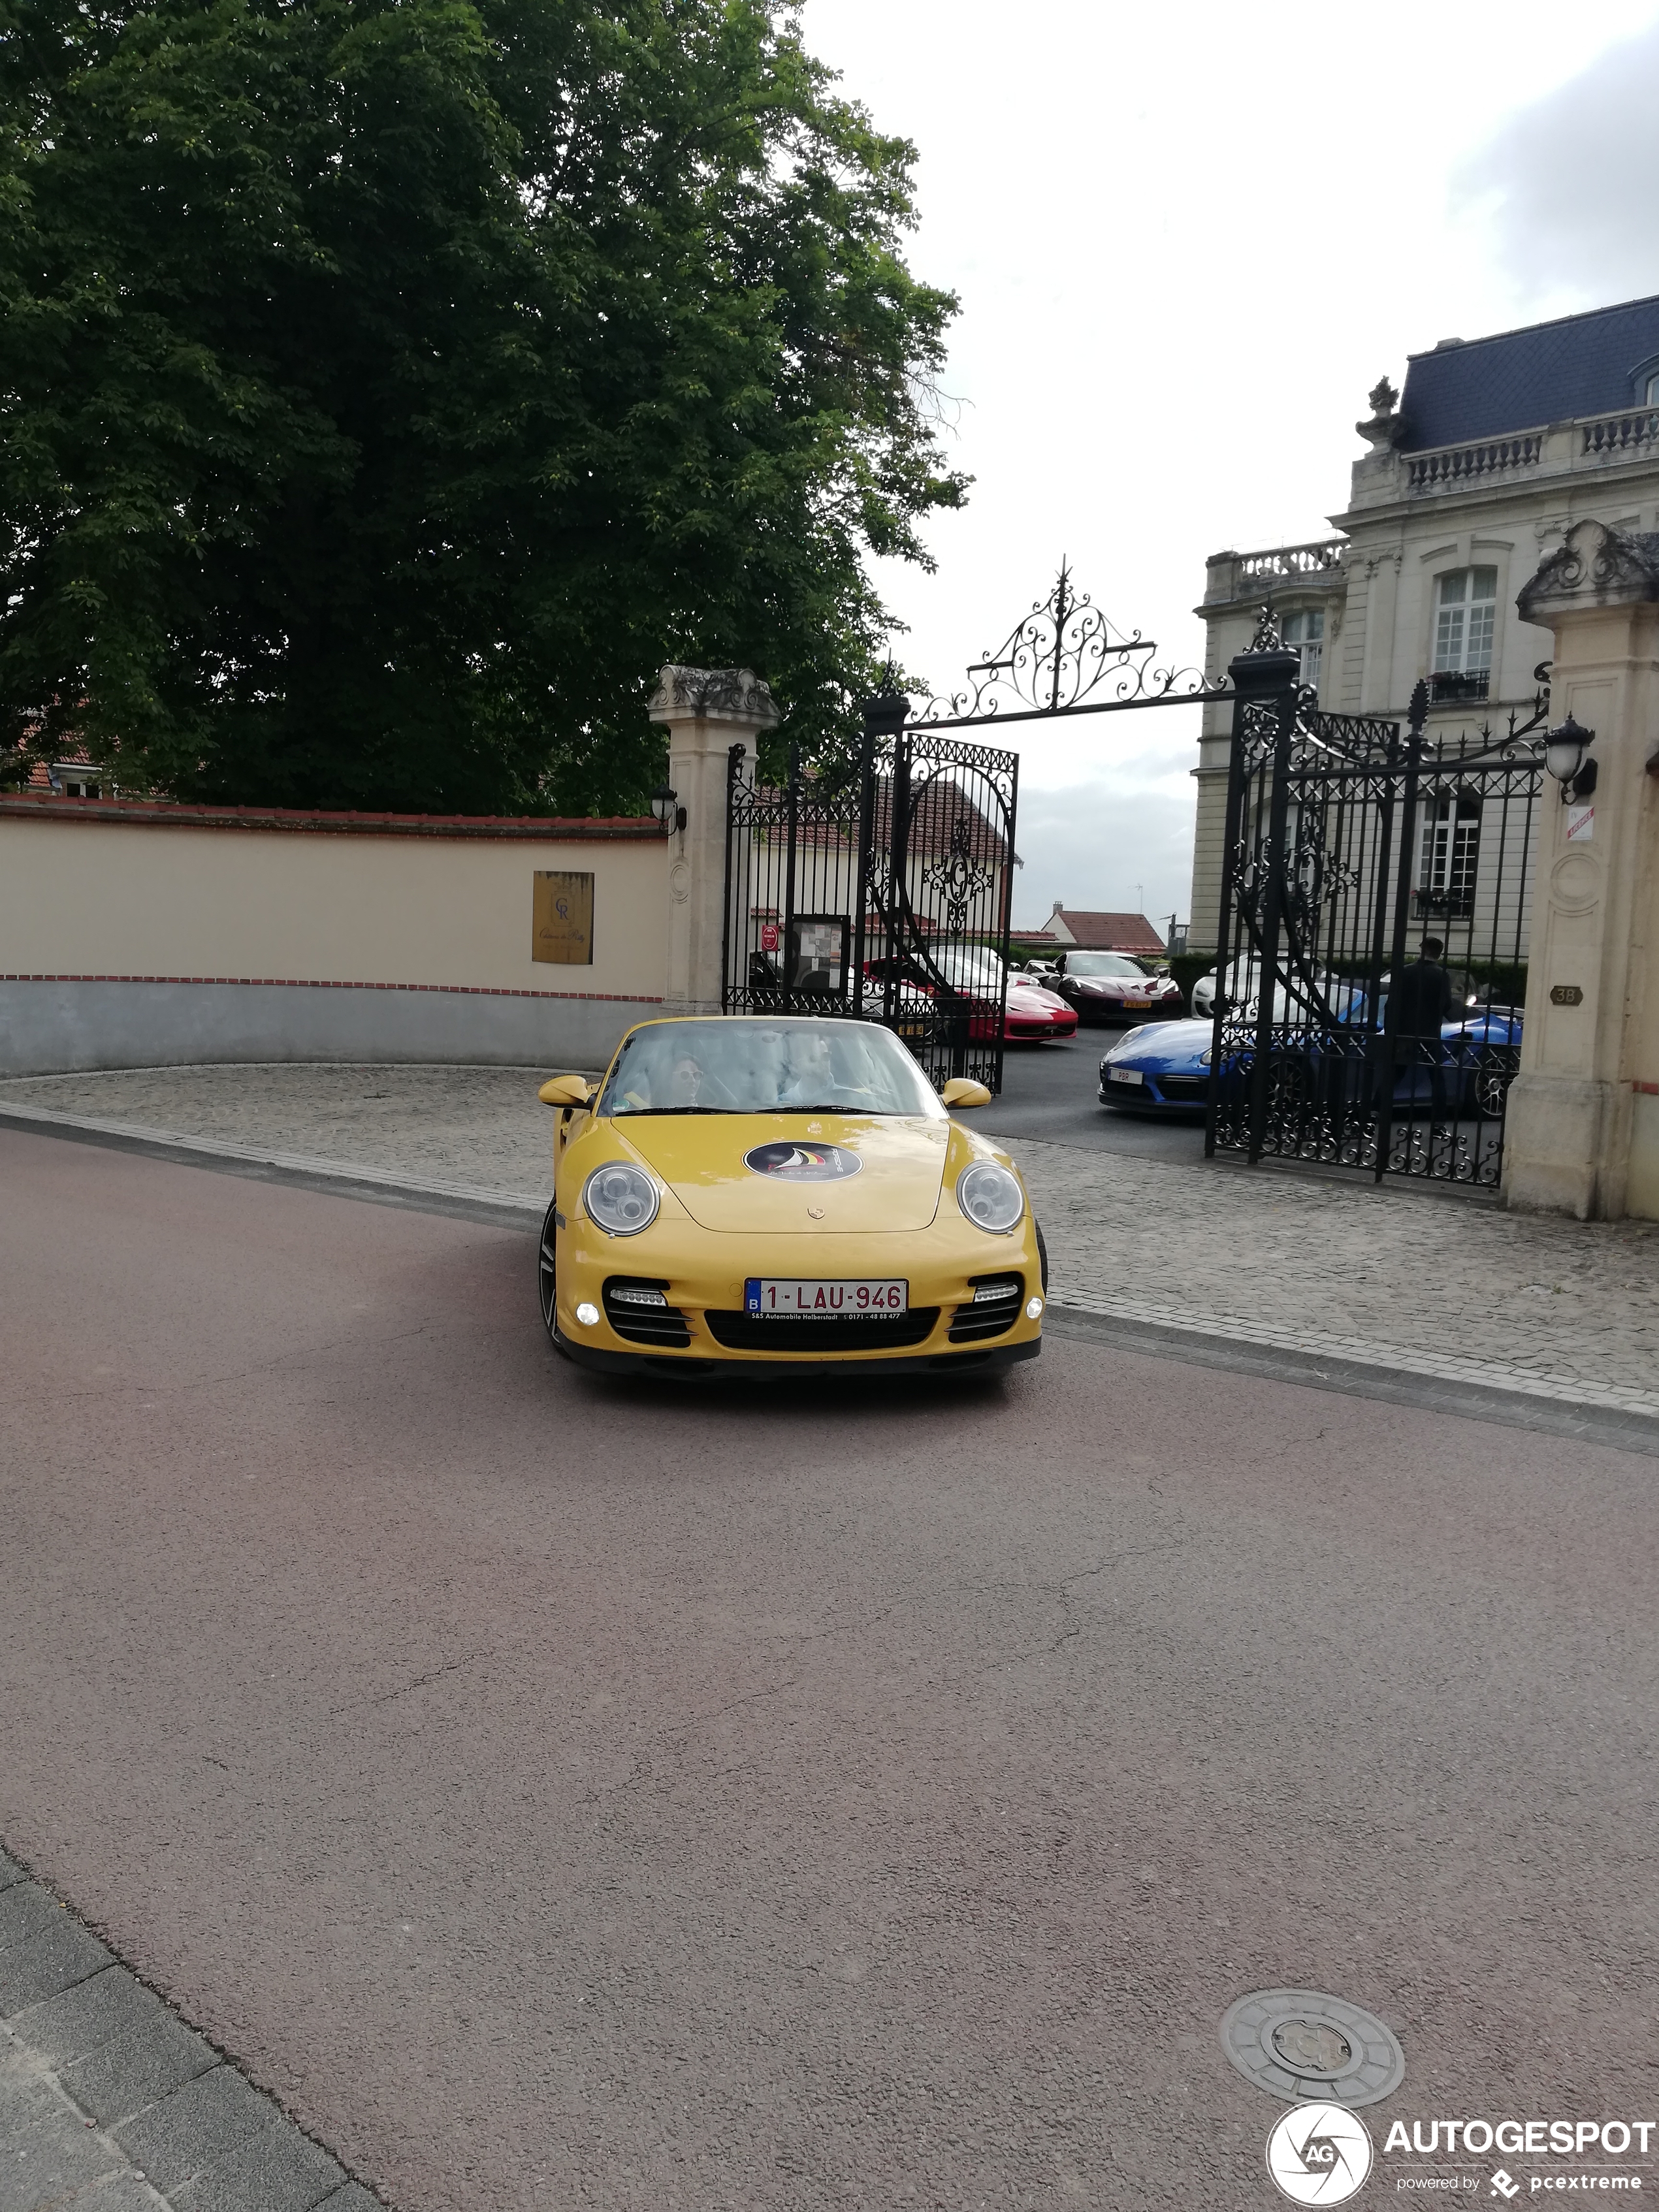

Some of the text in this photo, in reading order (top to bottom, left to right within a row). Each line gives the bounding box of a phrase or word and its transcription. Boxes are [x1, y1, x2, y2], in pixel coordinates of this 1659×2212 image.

[1556, 989, 1575, 1002] 38
[1118, 1072, 1129, 1082] PBR
[749, 1299, 758, 1309] B
